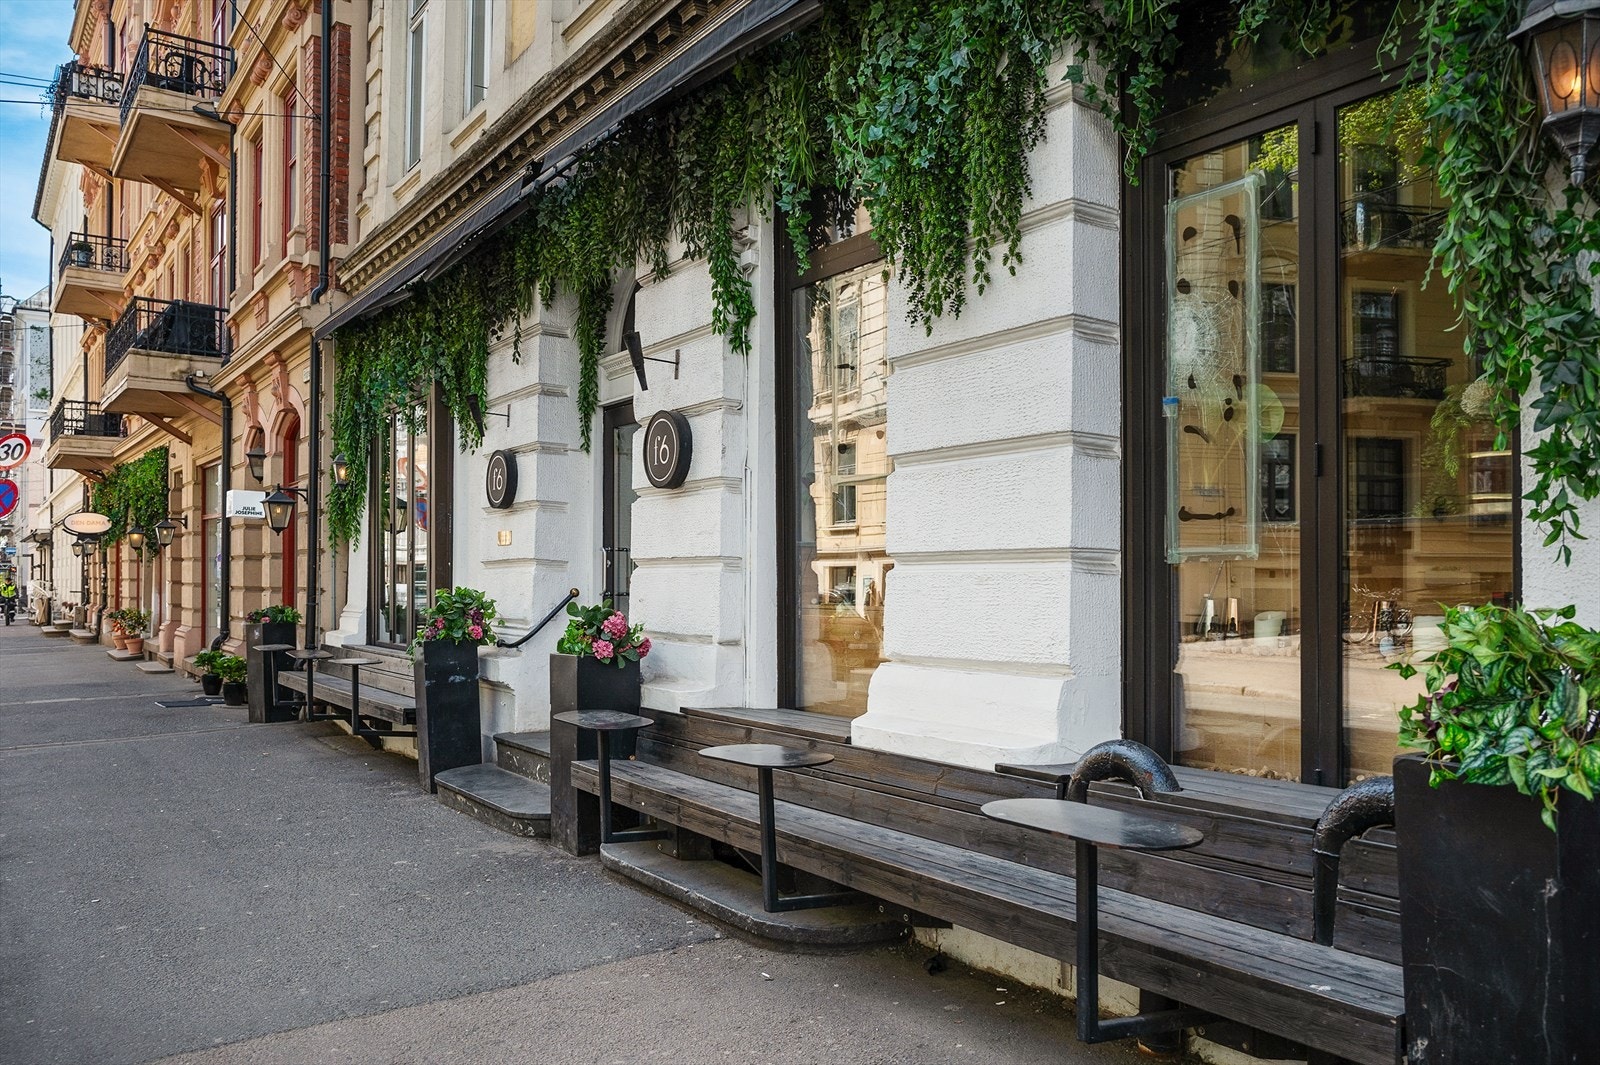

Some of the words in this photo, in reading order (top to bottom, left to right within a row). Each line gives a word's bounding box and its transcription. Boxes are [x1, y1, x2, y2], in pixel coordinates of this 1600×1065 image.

[0, 442, 24, 461] 30
[653, 434, 670, 466] f6
[492, 467, 503, 491] f6
